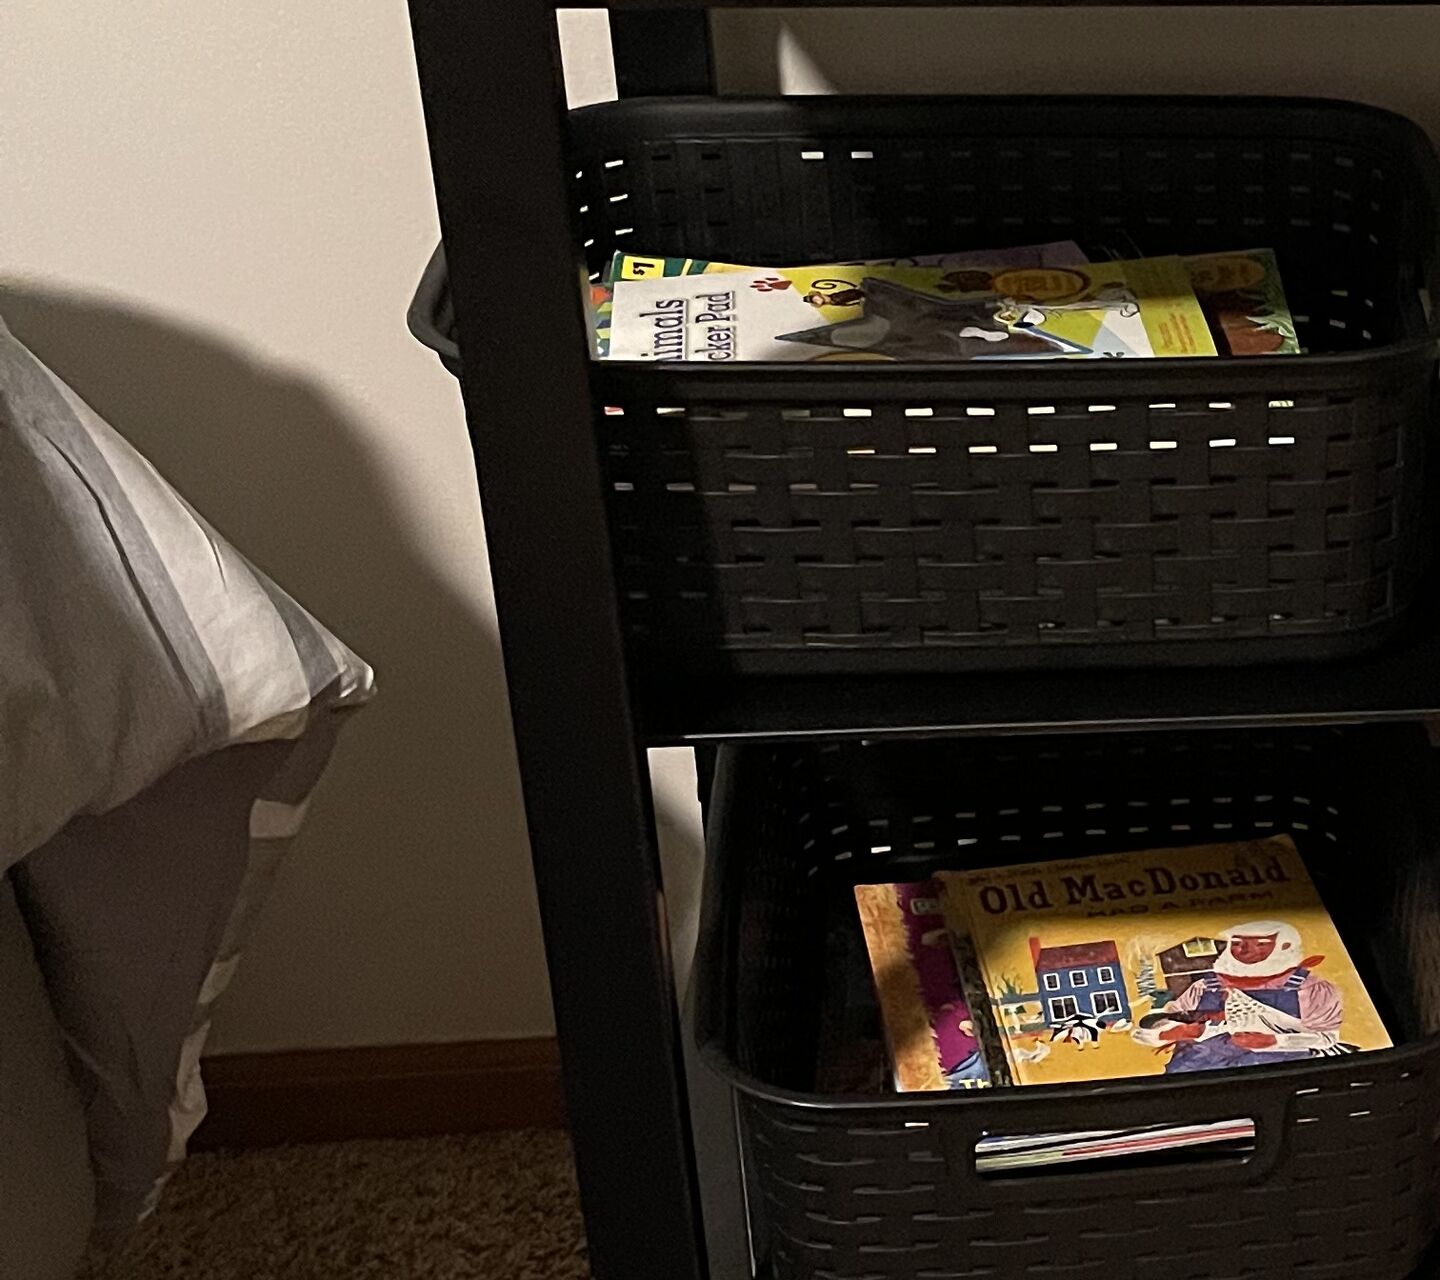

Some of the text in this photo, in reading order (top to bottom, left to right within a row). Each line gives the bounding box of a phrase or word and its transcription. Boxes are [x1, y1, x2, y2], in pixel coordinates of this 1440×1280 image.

[695, 292, 732, 324] Pad
[979, 879, 1054, 915] Old
[1061, 857, 1291, 906] MacDonald
[1087, 904, 1150, 918] HAD
